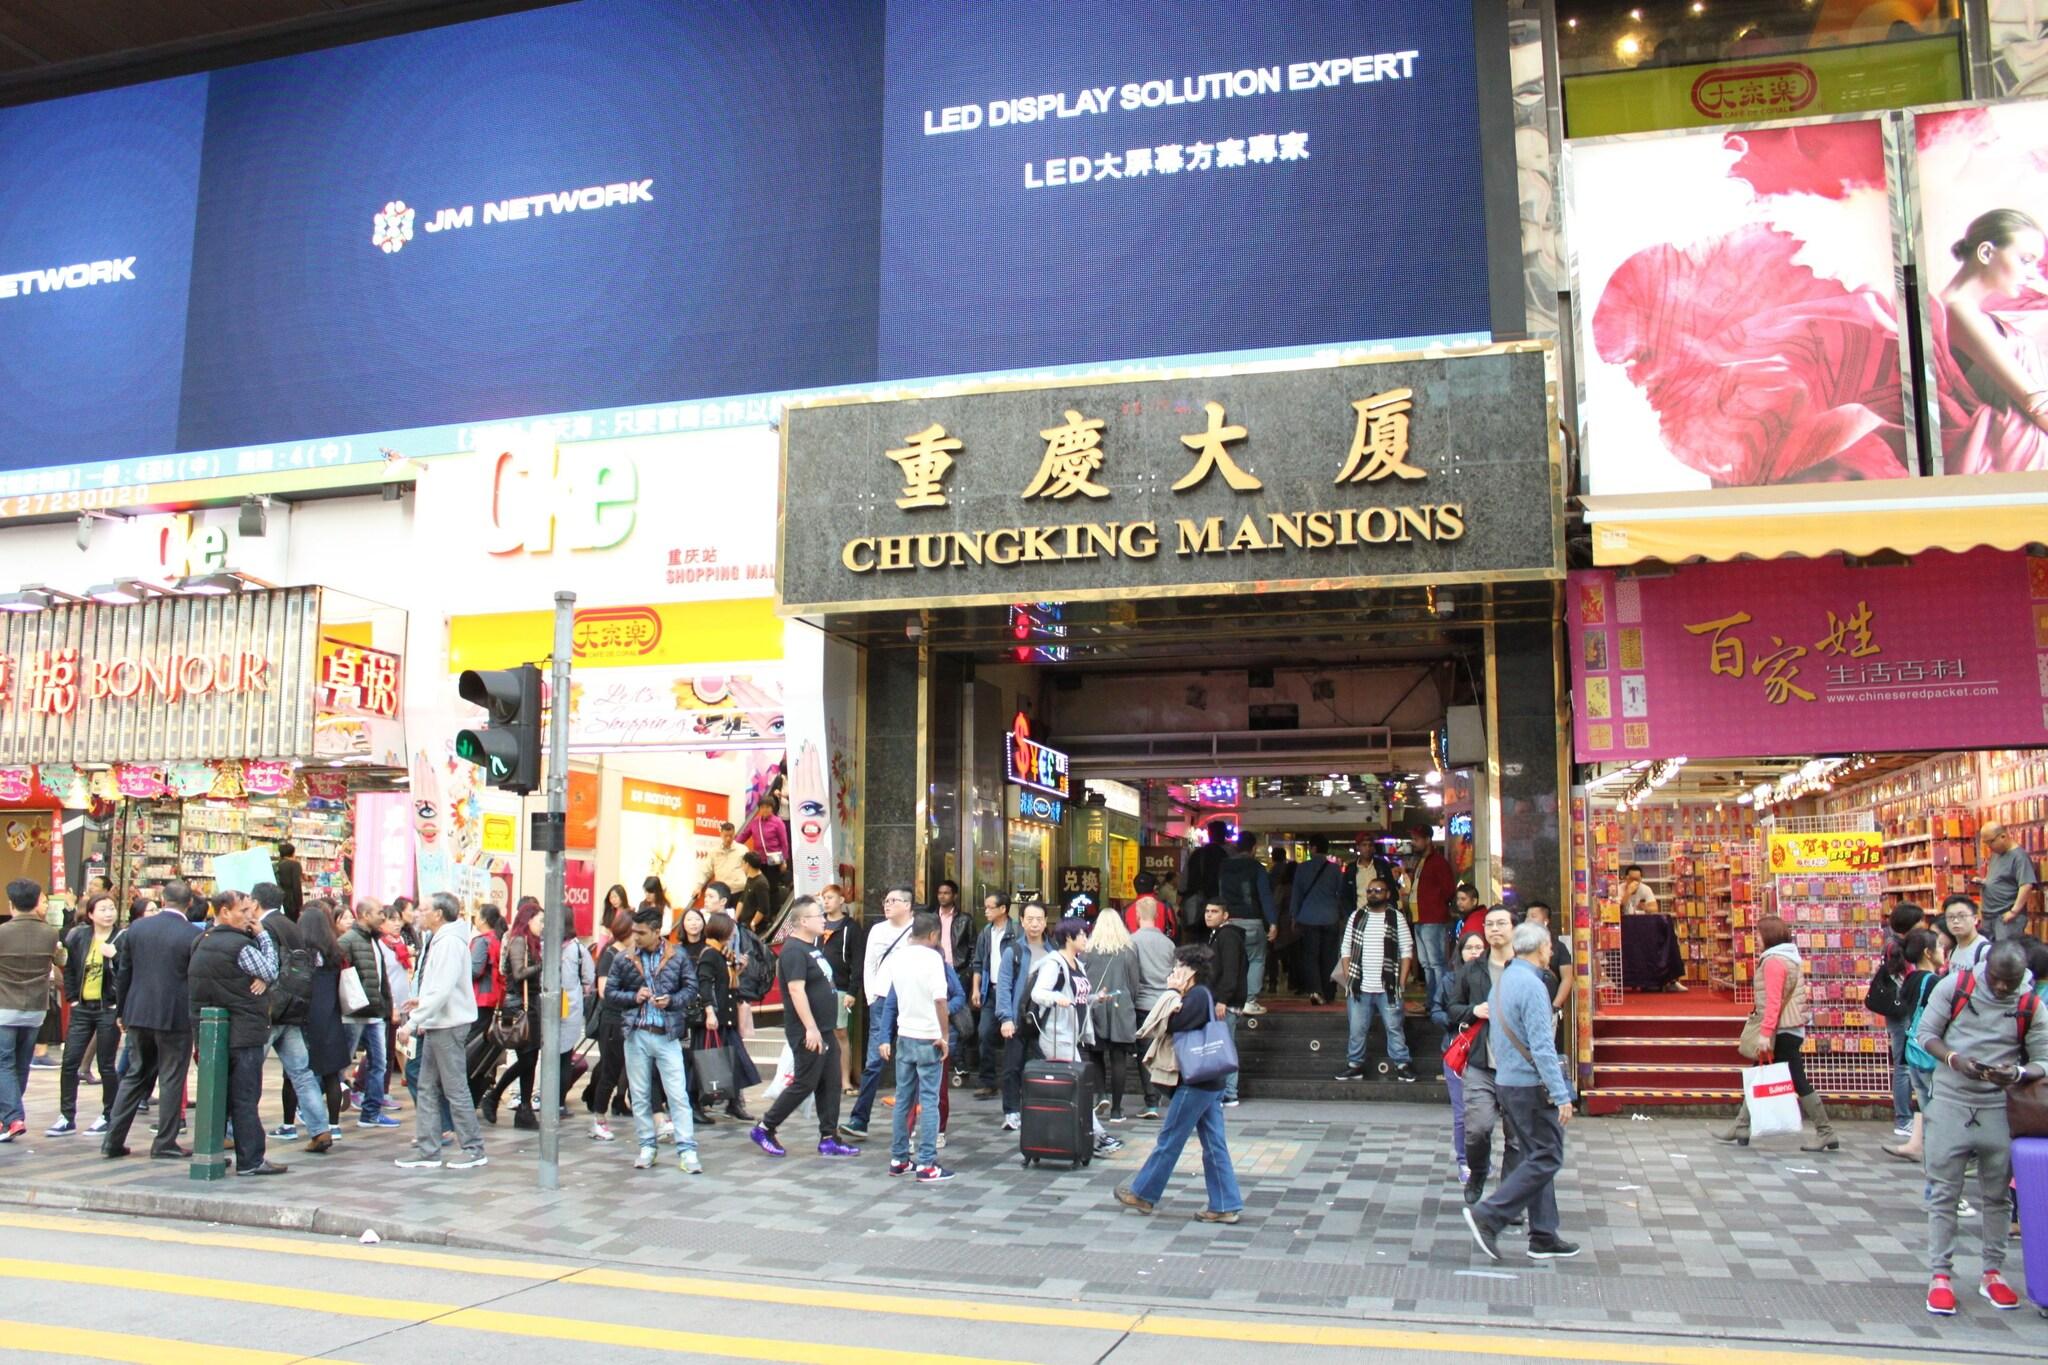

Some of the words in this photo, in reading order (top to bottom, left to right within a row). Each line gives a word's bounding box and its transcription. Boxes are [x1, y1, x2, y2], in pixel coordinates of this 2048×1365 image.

[924, 104, 982, 135] LED
[988, 86, 1116, 128] DISPLAY
[1120, 66, 1281, 110] SOLUTION
[1288, 51, 1419, 92] EXPERT
[425, 206, 473, 233] JM
[483, 179, 654, 226] NETWORK
[667, 546, 718, 566] 重庆站
[841, 519, 1159, 574] CHUNGKING
[1176, 502, 1467, 556] MANSIONS
[665, 566, 740, 585] SHOPPING
[90, 650, 270, 704] BONJOUR
[1684, 601, 1882, 705] 百家姓
[1826, 659, 1967, 685] 生活百科
[1826, 686, 1999, 703] www.chineseredpacket.com
